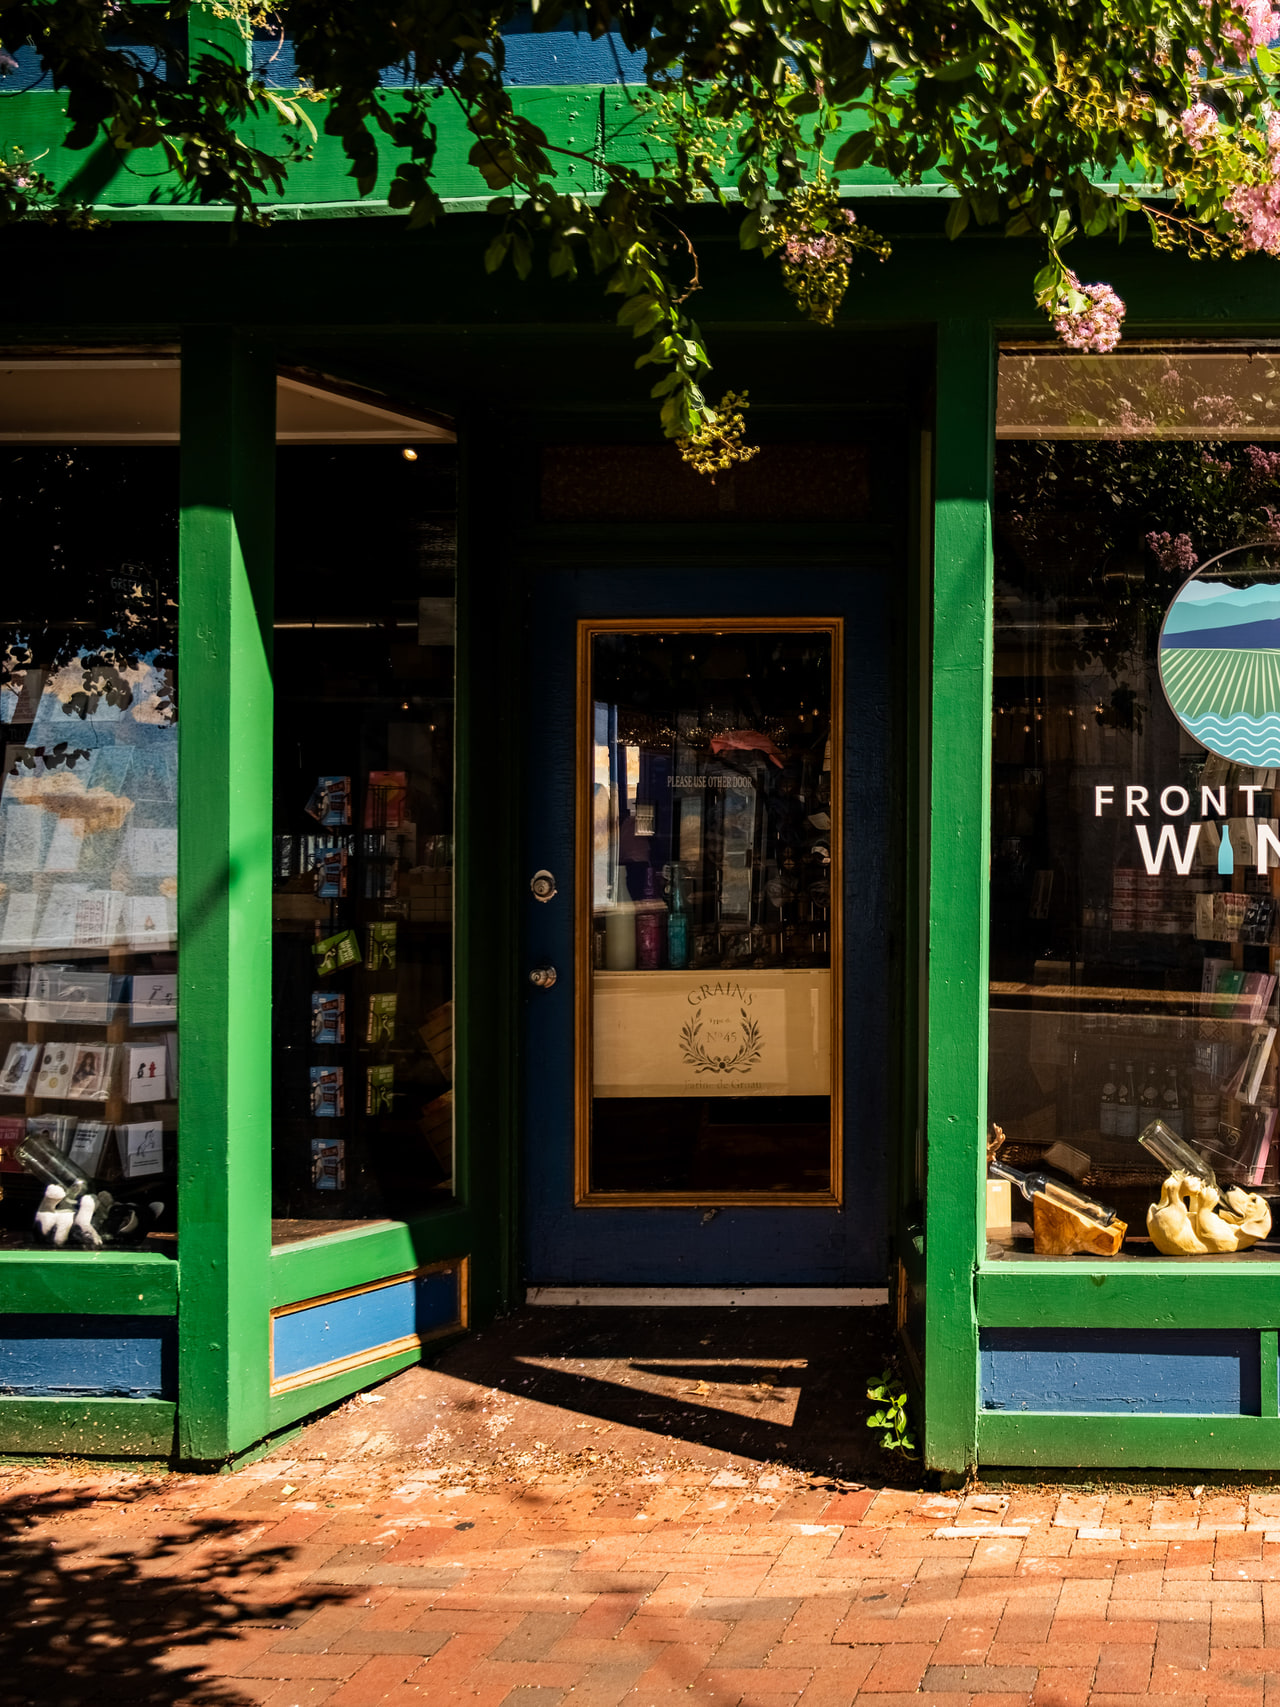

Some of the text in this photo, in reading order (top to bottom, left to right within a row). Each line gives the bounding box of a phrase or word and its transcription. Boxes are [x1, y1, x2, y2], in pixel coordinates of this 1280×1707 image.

[667, 776, 753, 788] PLEASE USE OTHER DOOR
[1095, 785, 1263, 817] FRONT
[687, 981, 753, 1006] GRAINS
